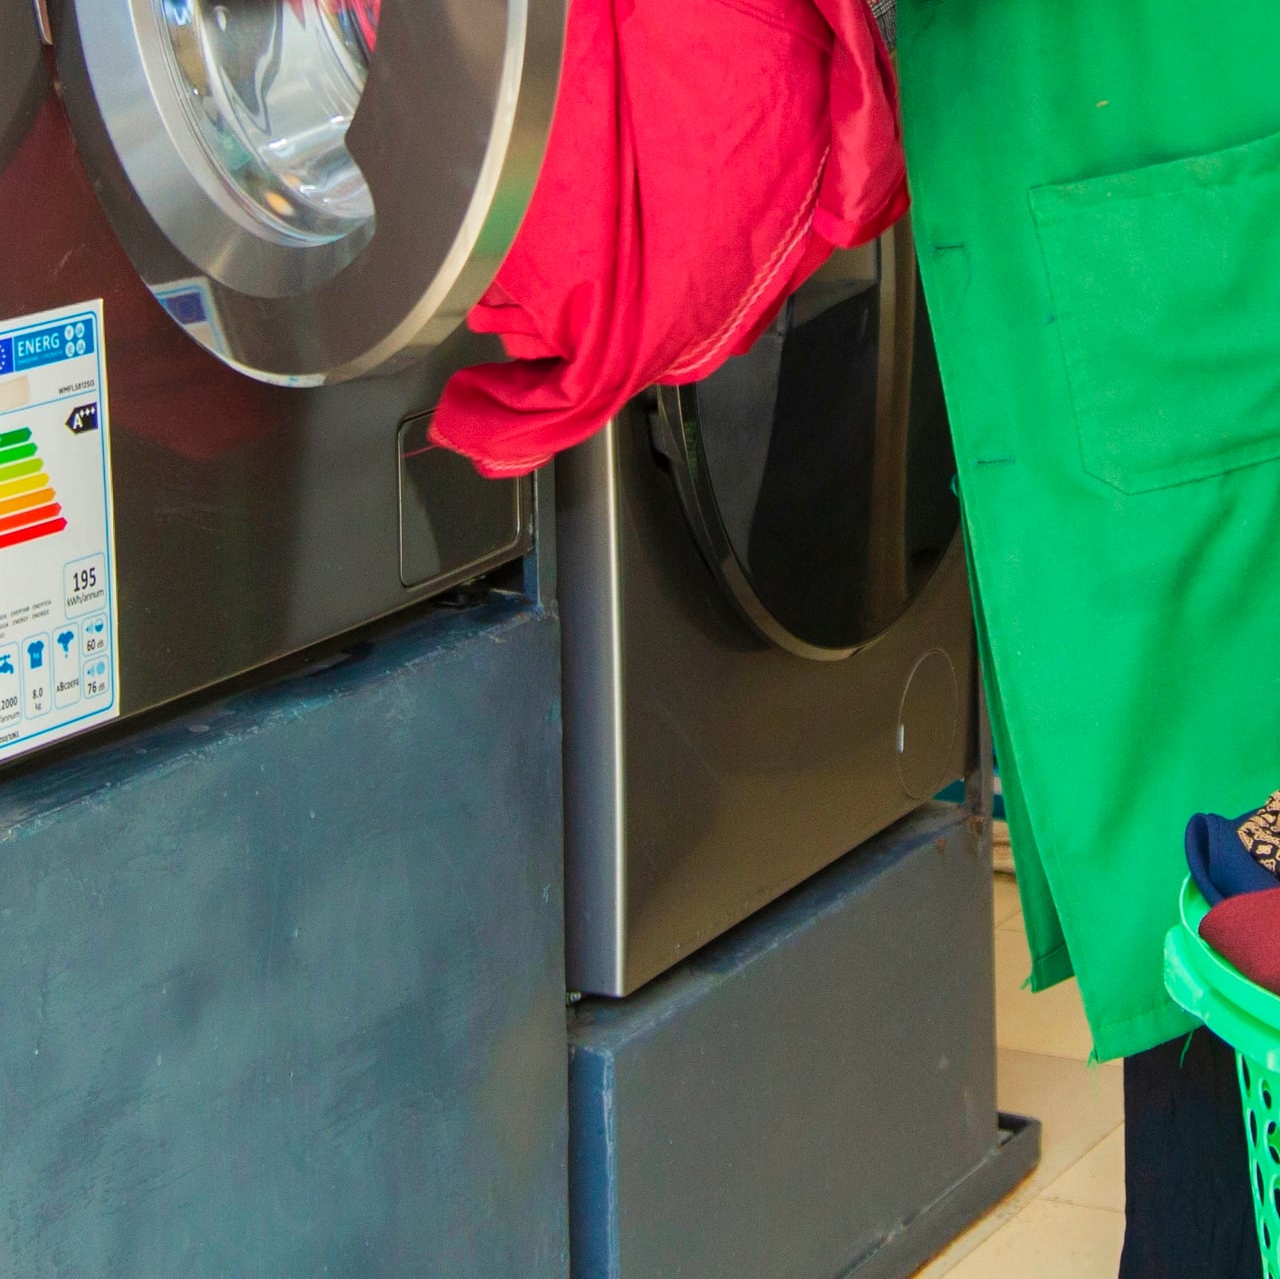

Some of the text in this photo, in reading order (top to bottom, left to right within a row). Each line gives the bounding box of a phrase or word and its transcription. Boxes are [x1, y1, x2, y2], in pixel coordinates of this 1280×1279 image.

[17, 332, 60, 358] ENERG
[72, 567, 97, 593] 195
[86, 639, 96, 652] 60
[32, 687, 44, 701] 8.0
[87, 681, 97, 694] 76
